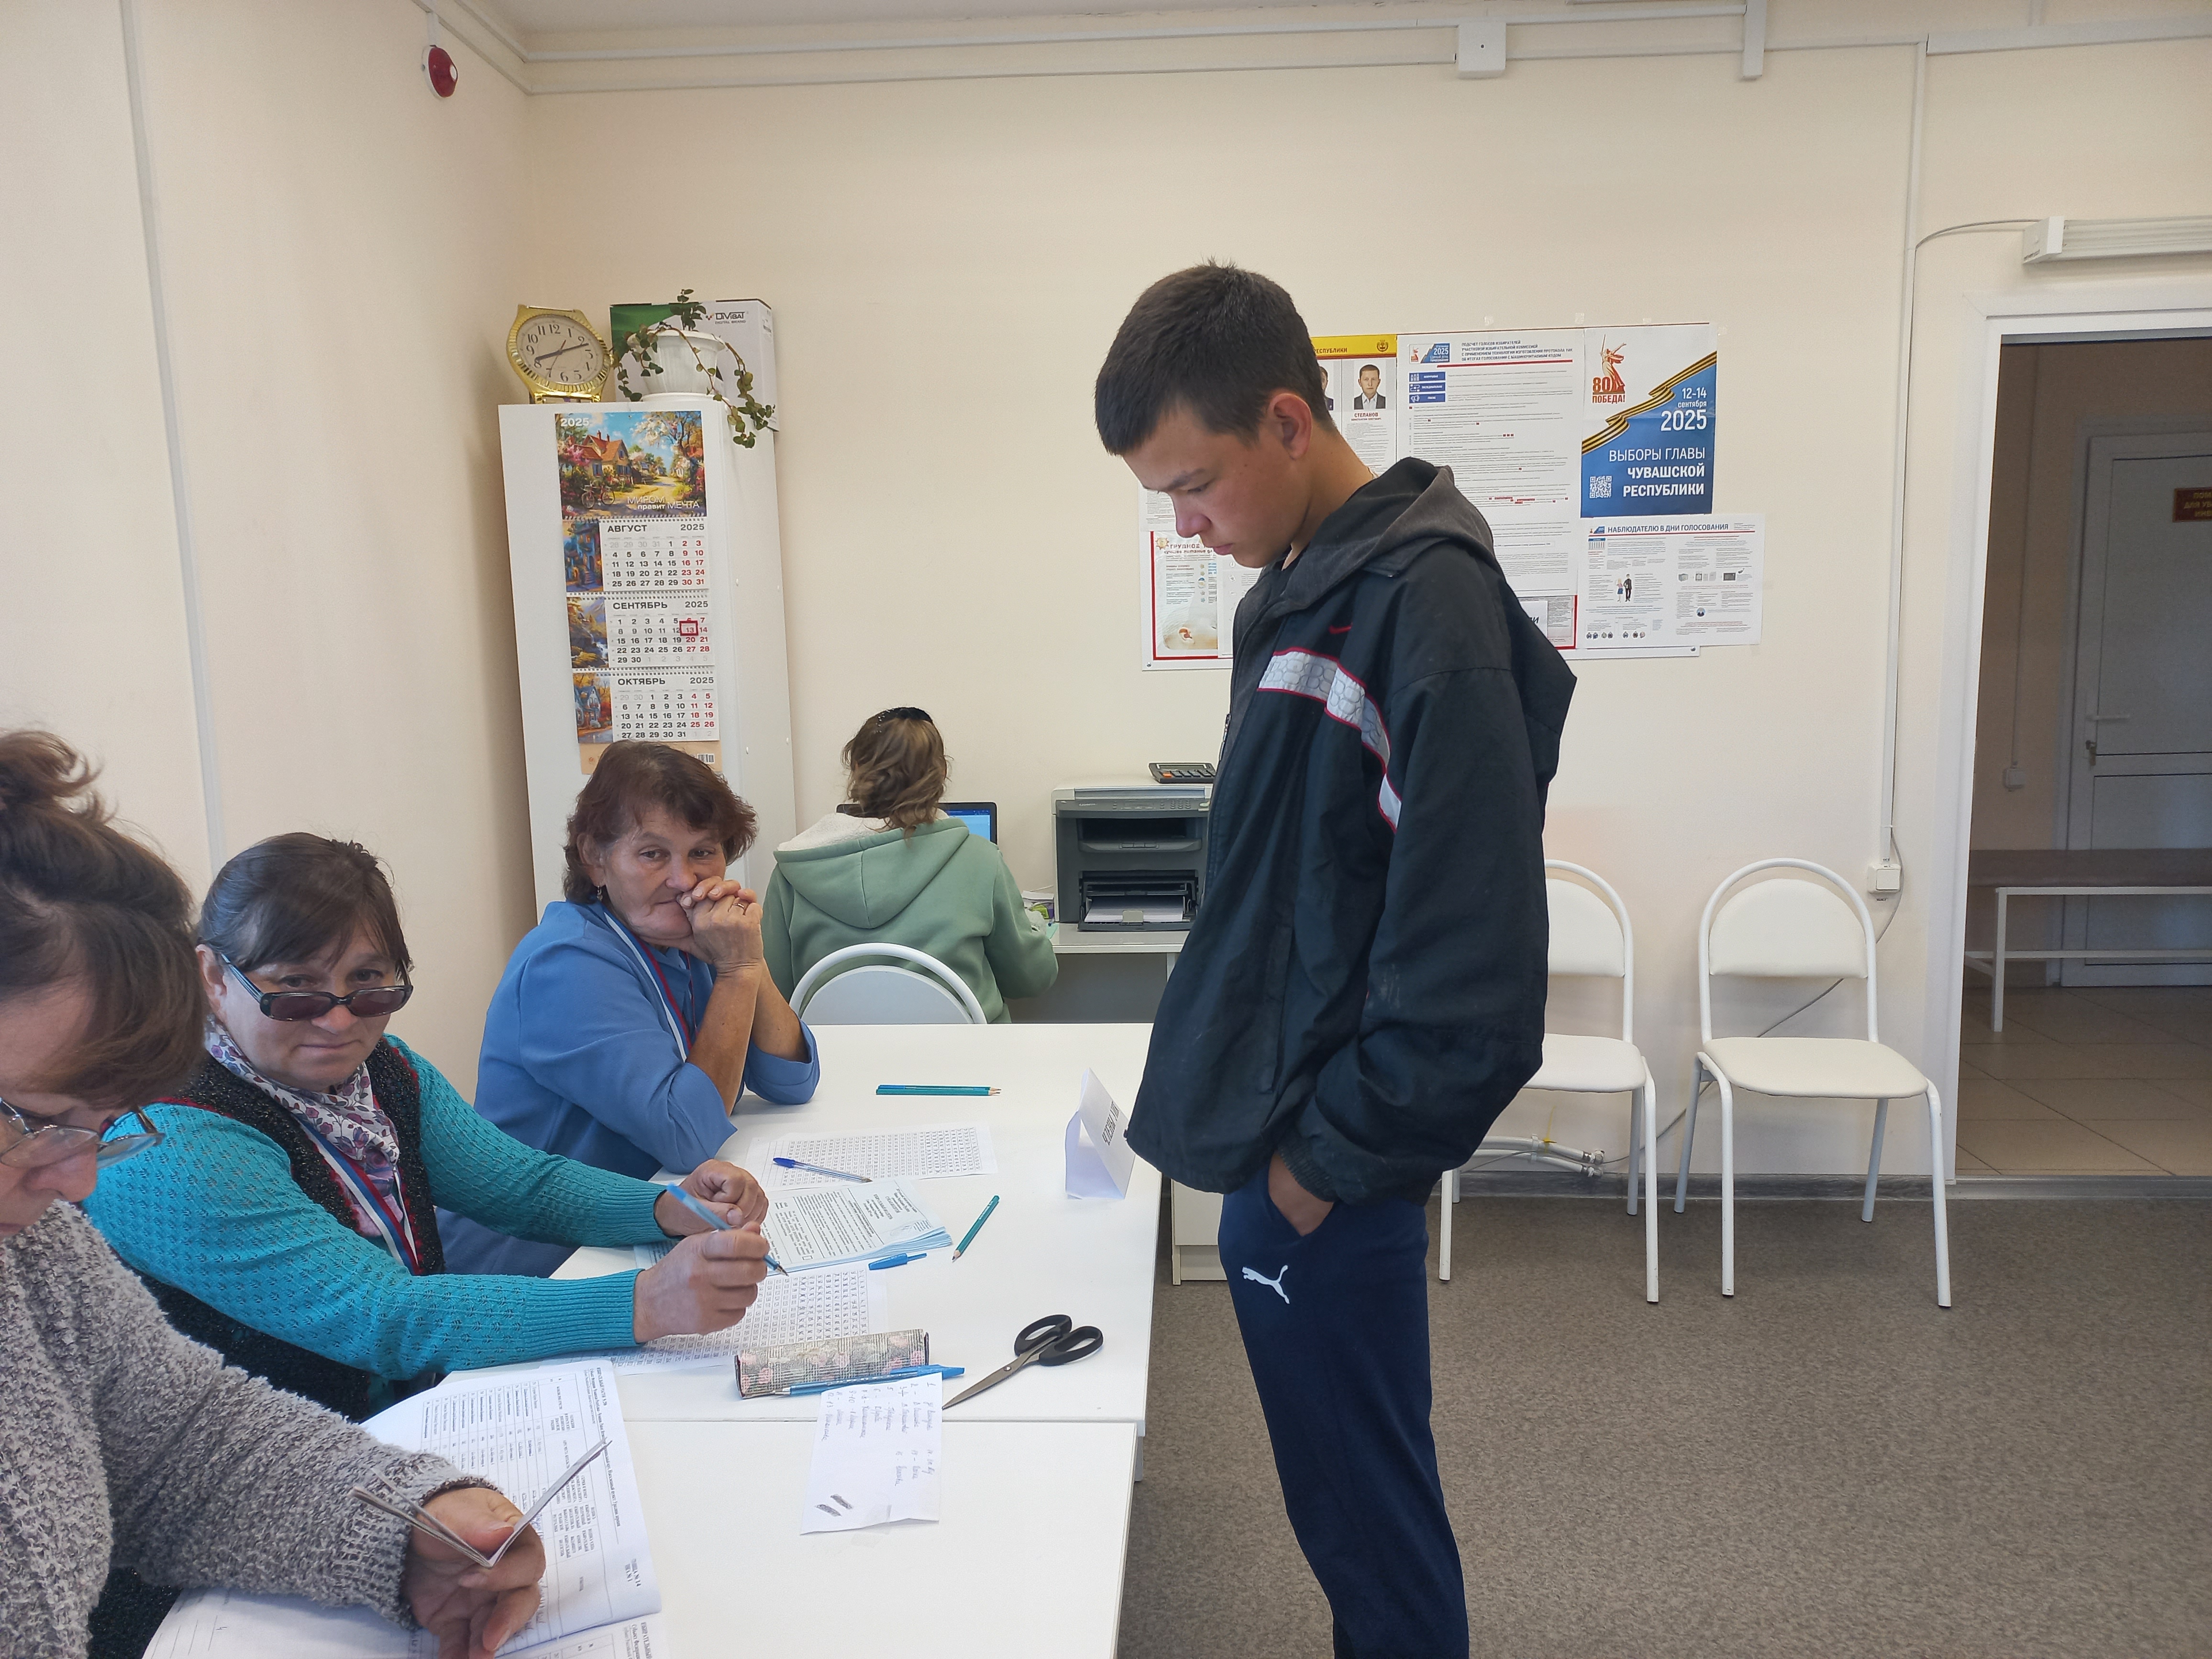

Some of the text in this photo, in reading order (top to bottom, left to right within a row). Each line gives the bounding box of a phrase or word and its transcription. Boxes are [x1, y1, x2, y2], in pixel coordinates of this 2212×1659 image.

[538, 325, 545, 335] 11
[549, 324, 561, 334] 12
[568, 328, 572, 338] 1
[528, 334, 538, 343] 10
[578, 336, 585, 345] 2
[526, 345, 535, 355] 9
[534, 359, 542, 368] 8
[546, 368, 552, 378] 7
[560, 372, 568, 382] 6
[1592, 377, 1610, 393] 80
[1682, 387, 1707, 399] 12-14
[1592, 394, 1625, 404] ПОБЕДА!
[1678, 400, 1707, 409] сентября
[560, 418, 589, 427] 2025
[1660, 409, 1707, 431] 2025
[1609, 447, 1705, 462] ВЫБОРЫ ГЛАВЫ
[1627, 463, 1704, 479] ЧУВАШСКОЙ
[1623, 483, 1704, 497] РЕСПУБЛИКИ
[628, 496, 665, 504] МИРОМ
[637, 501, 700, 511] правит МЕЧТА
[1102, 1114, 1116, 1146] ЧЛЕНЫ
